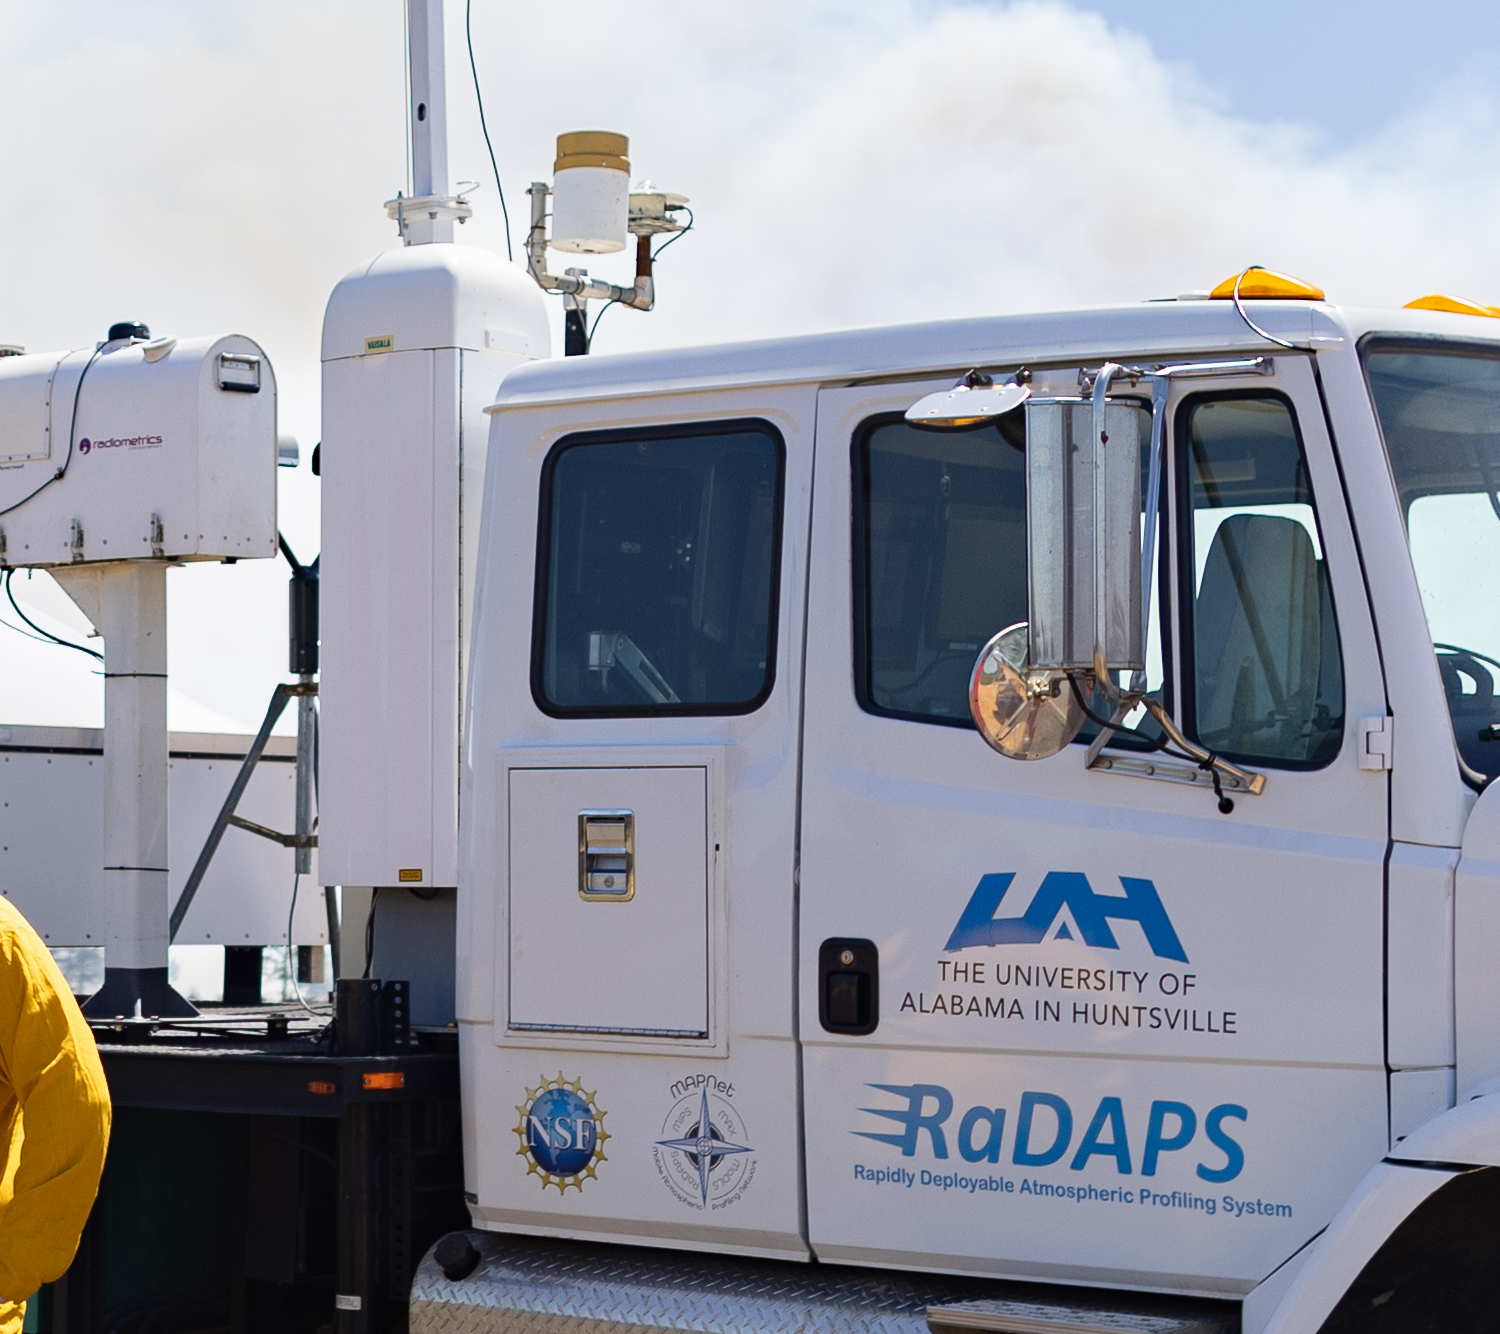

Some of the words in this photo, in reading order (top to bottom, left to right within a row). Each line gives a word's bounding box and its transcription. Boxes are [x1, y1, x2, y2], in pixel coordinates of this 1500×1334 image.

[93, 435, 163, 449] radiometrics
[943, 871, 1190, 965] UAH
[937, 960, 985, 984] THE
[996, 963, 1148, 993] UNIVERSITY
[1159, 973, 1196, 996] OF
[900, 992, 1024, 1020] ALABAMA
[1035, 1000, 1060, 1022] IN
[1073, 1002, 1237, 1034] HUNTSVILLE
[670, 1074, 735, 1099] MAPNet
[528, 1115, 595, 1151] NSF
[672, 1107, 692, 1133] MIPS
[717, 1110, 737, 1137] MAX
[901, 1083, 1248, 1184] RaDAPS
[854, 1164, 915, 1188] Rapidly
[920, 1169, 1015, 1193] Deployable
[1019, 1178, 1134, 1203] Atmospheric
[1139, 1188, 1216, 1215] Profiling
[1222, 1195, 1293, 1217] System
